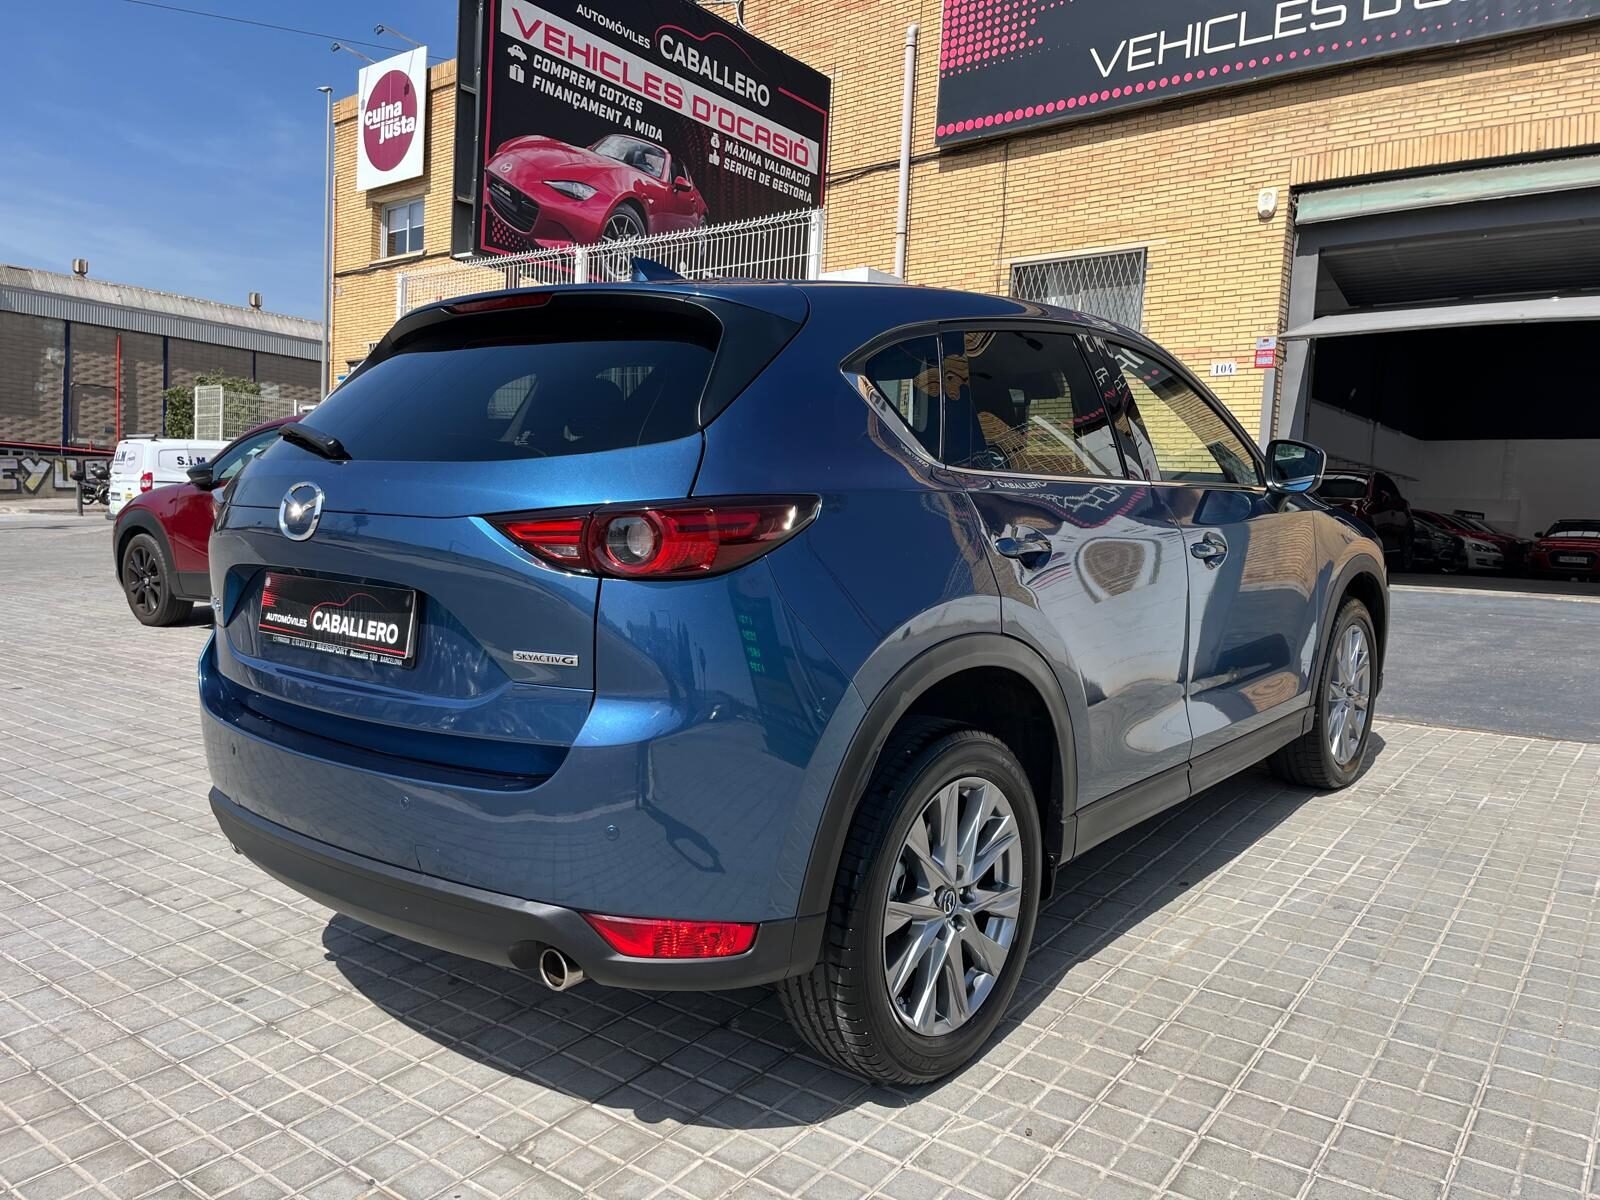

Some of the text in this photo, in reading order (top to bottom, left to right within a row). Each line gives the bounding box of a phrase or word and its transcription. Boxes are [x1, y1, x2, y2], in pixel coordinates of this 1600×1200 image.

[576, 4, 770, 107] AUTOMÓVILES CABALLERO
[1090, 0, 1347, 78] VEHICLES
[512, 7, 809, 167] VEHICLES D'OCASIÓ
[533, 54, 643, 113] COMPREM COTXES
[365, 101, 402, 126] cuina
[379, 115, 415, 144] justa
[532, 75, 663, 142] FINANÇAMENT A MIDA
[724, 140, 810, 187] MÀXIMA VALORACIÓ
[724, 157, 812, 204] SERVEI DE GESTORIA
[1215, 364, 1232, 374] 104
[266, 612, 307, 628] AUTOMÓVILES
[313, 611, 399, 644] CABALLERO
